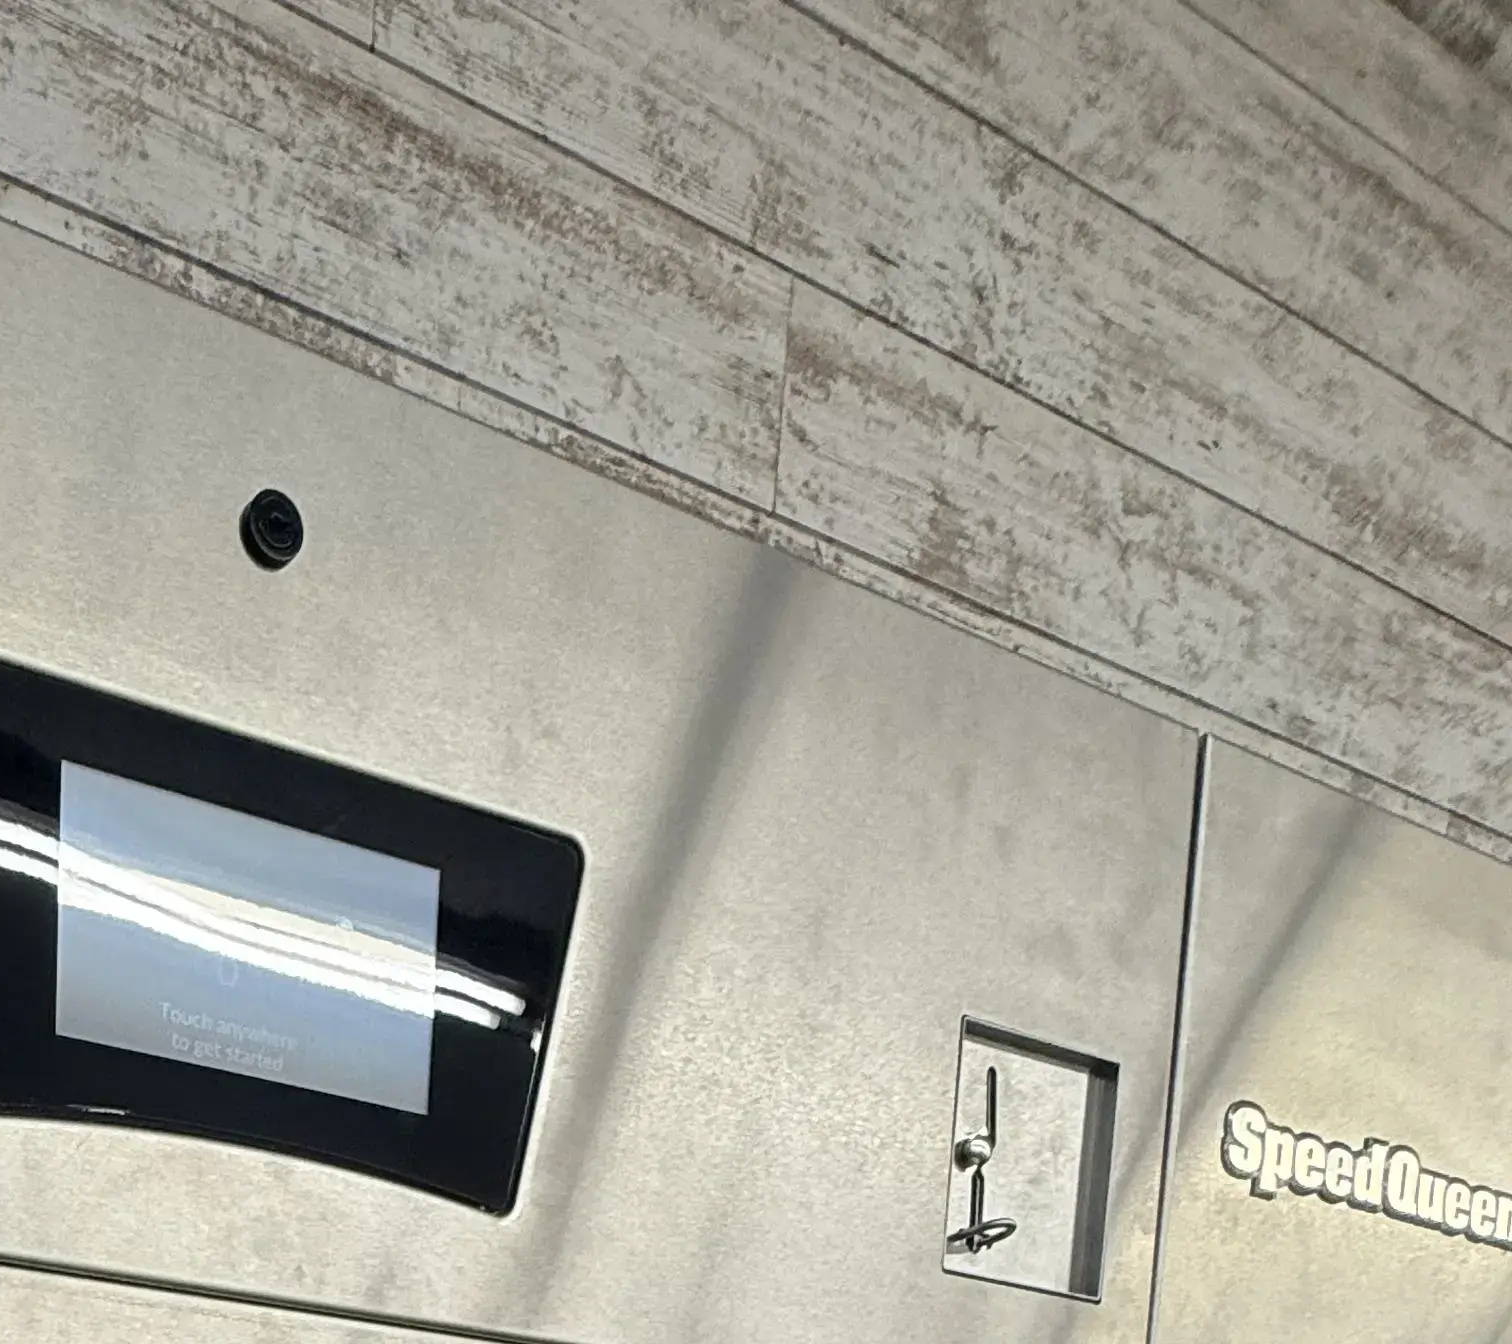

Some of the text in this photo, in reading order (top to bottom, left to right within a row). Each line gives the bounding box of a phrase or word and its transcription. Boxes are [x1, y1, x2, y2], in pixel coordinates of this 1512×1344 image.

[158, 1001, 213, 1031] Touch
[171, 1031, 284, 1073] to get started
